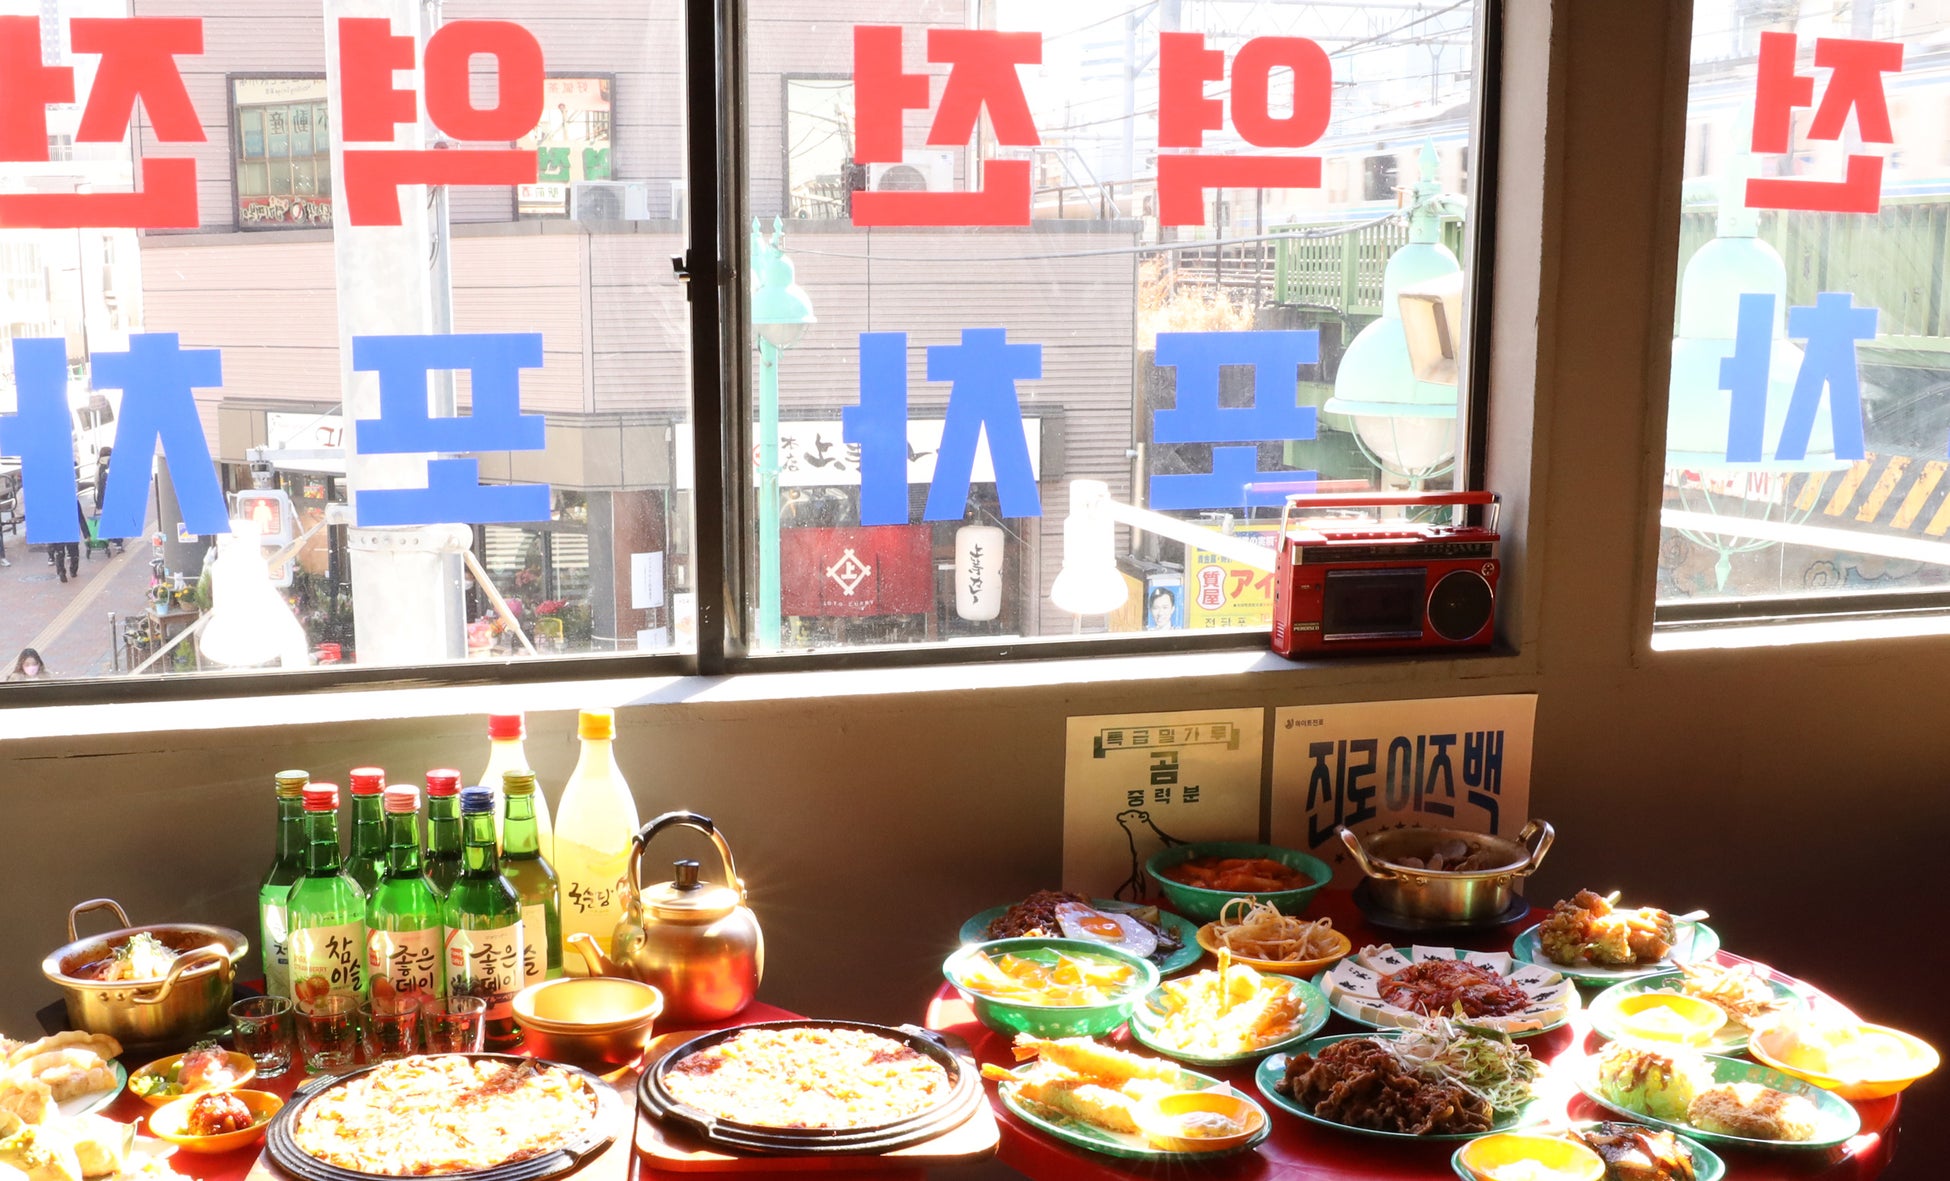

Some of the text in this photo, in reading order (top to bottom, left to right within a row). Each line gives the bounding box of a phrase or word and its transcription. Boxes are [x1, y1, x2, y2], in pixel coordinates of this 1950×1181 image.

[1202, 570, 1220, 605] 質屋
[1150, 750, 1178, 785] 곰
[1127, 785, 1200, 807] 중력분
[325, 935, 353, 965] 참
[390, 944, 435, 977] 좋은
[470, 943, 517, 975] 좋은
[331, 958, 363, 992] 이슬
[396, 972, 434, 992] 데이
[481, 969, 517, 991] 데이
